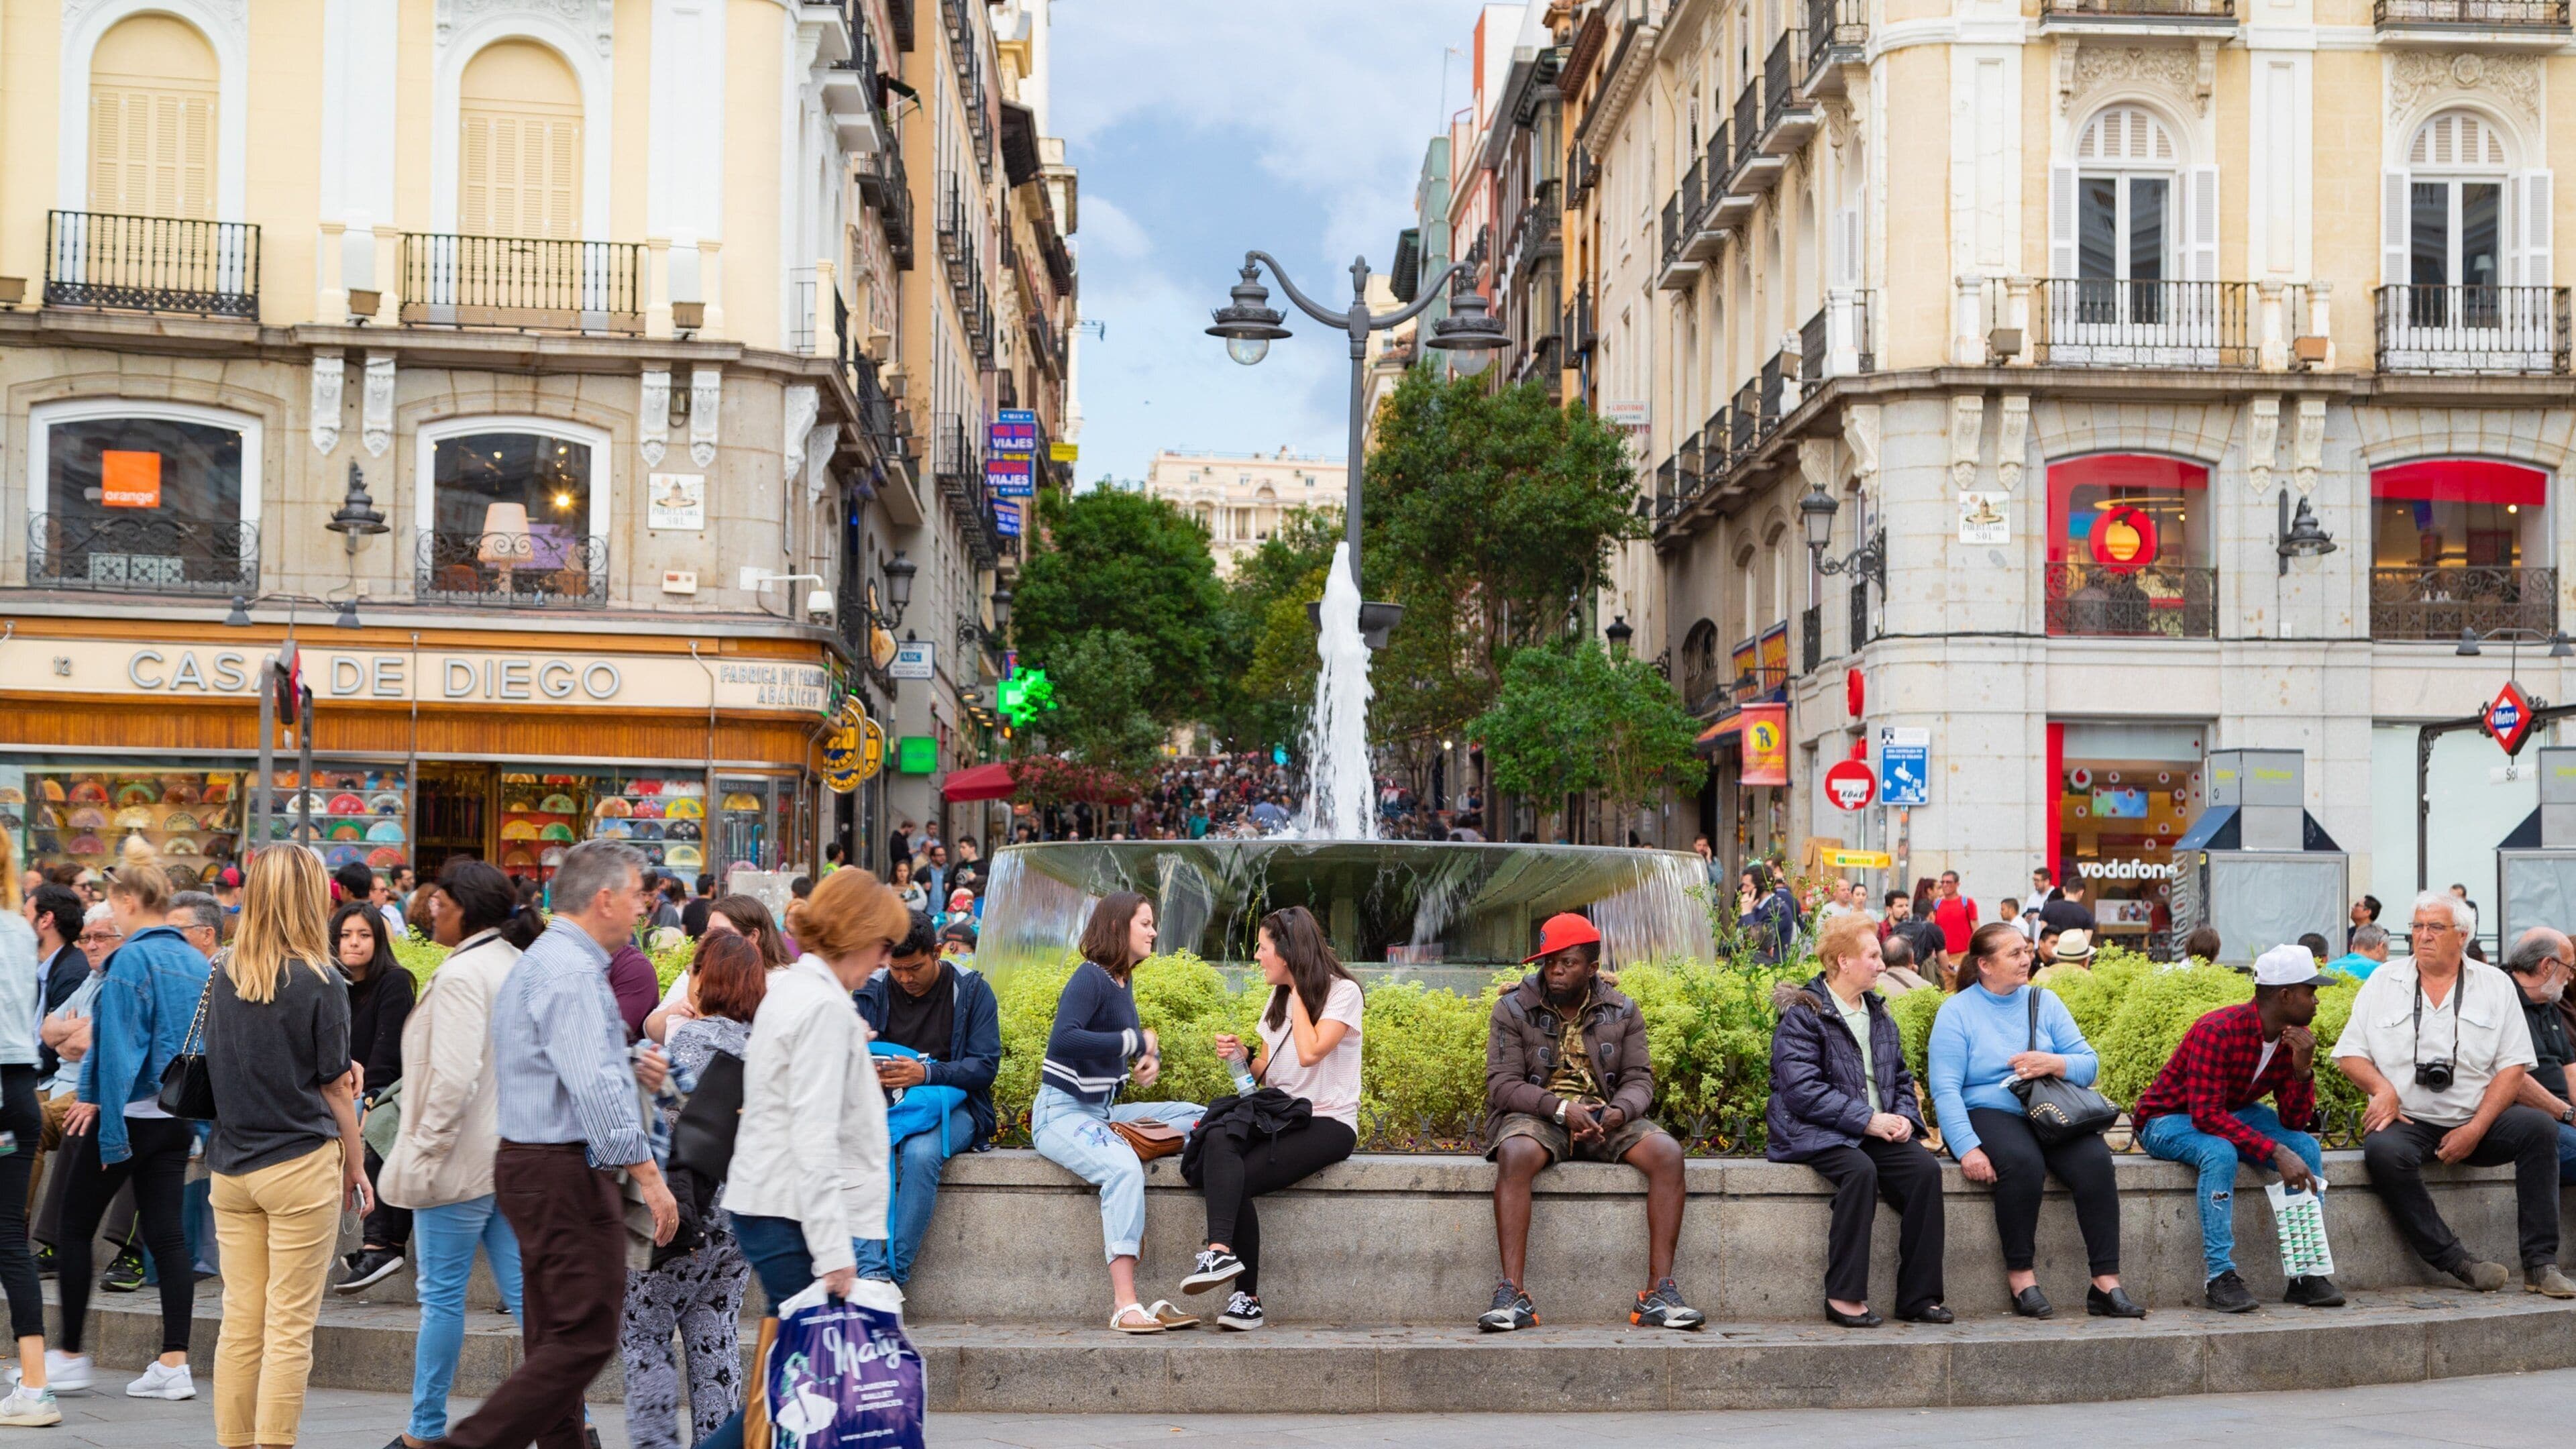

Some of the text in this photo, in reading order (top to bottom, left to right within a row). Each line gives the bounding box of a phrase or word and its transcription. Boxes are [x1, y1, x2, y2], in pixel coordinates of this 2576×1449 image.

[993, 437, 1034, 449] VIAJES
[987, 474, 1030, 486] VIAJES
[104, 491, 154, 505] orange
[1975, 531, 1992, 540] SOL
[54, 656, 70, 676] 12
[331, 655, 403, 696] DE
[444, 658, 621, 700] DIEGO
[720, 665, 777, 685] FABRICA
[782, 667, 796, 686] DE
[757, 686, 818, 707] ABANICOS
[2496, 710, 2515, 725] Metro
[2506, 767, 2518, 781] Sol
[2077, 858, 2178, 879] vodafone
